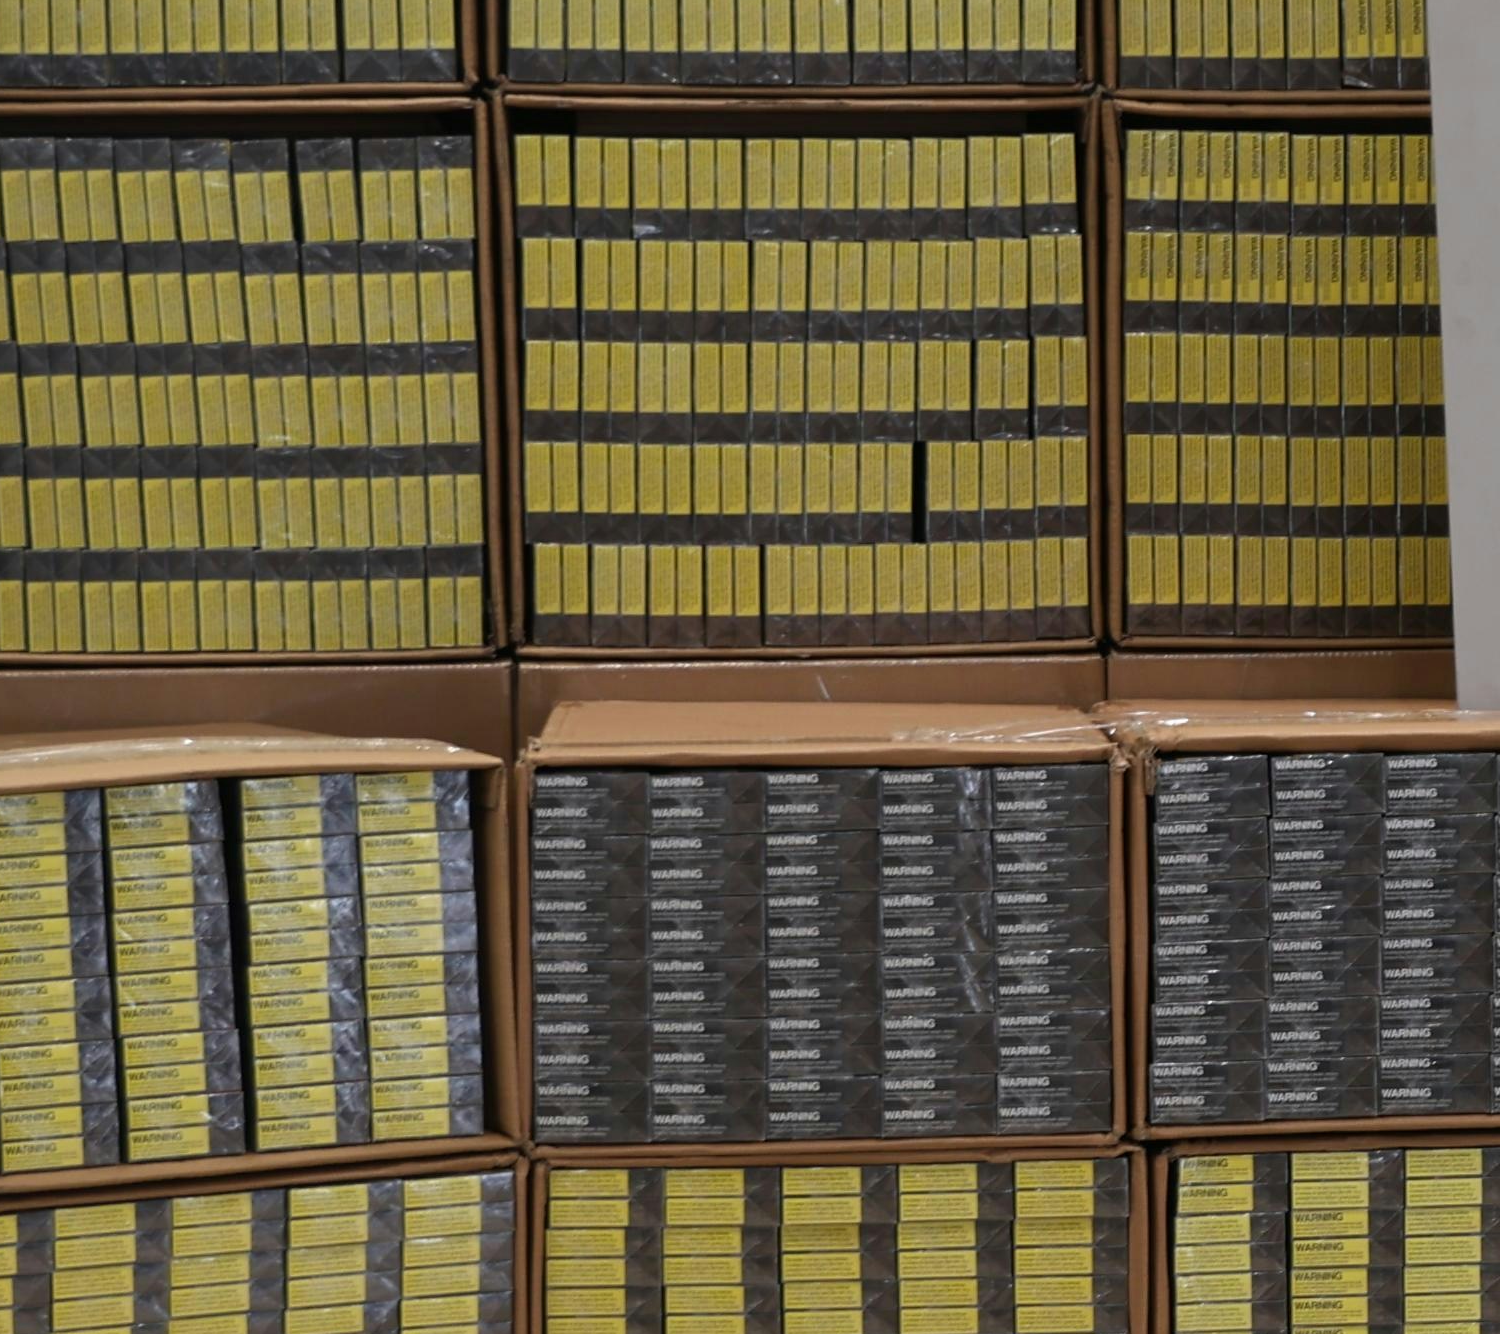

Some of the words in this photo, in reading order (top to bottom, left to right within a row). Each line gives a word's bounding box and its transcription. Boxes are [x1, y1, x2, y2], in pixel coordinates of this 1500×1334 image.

[1388, 758, 1437, 769] WARNING
[1160, 793, 1209, 804] WARNING
[652, 807, 703, 818] WARNING
[768, 803, 819, 814] WARNING
[1158, 824, 1207, 835] WARNING
[1274, 820, 1323, 831] WARNING
[1386, 819, 1435, 830] WARNING
[651, 838, 702, 849] WARNING
[766, 835, 817, 846] WARNING
[767, 865, 818, 876] WARNING
[883, 865, 934, 876] WARNING
[1272, 881, 1321, 892] WARNING
[768, 896, 819, 907] WARNING
[1385, 909, 1434, 920] WARNING
[1159, 915, 1208, 926] WARNING
[652, 930, 703, 941] WARNING
[769, 926, 820, 937] WARNING
[884, 926, 935, 937] WARNING
[1158, 945, 1207, 956] WARNING
[1273, 941, 1322, 952] WARNING
[653, 961, 704, 972] WARNING
[768, 958, 819, 969] WARNING
[118, 976, 172, 987] WARNING
[1159, 975, 1208, 986] WARNING
[769, 988, 820, 999] WARNING
[120, 1007, 174, 1018] WARNING
[1156, 1006, 1205, 1017] WARNING
[1269, 1002, 1318, 1013] WARNING
[125, 1038, 179, 1049] WARNING
[0, 1049, 53, 1060] WARNING
[769, 1049, 820, 1060] WARNING
[1000, 1045, 1051, 1056] WARNING
[1268, 1062, 1317, 1073] WARNING
[127, 1069, 181, 1080] WARNING
[1, 1080, 55, 1091] WARNING
[769, 1111, 820, 1122] WARNING
[884, 1109, 935, 1120] WARNING
[259, 1121, 313, 1132] WARNING
[130, 1132, 184, 1143] WARNING
[4, 1143, 58, 1154] WARNING
[1296, 1242, 1345, 1251] WARNING
[1295, 1271, 1344, 1280] WARNING
[1295, 1300, 1344, 1309] WARNING
